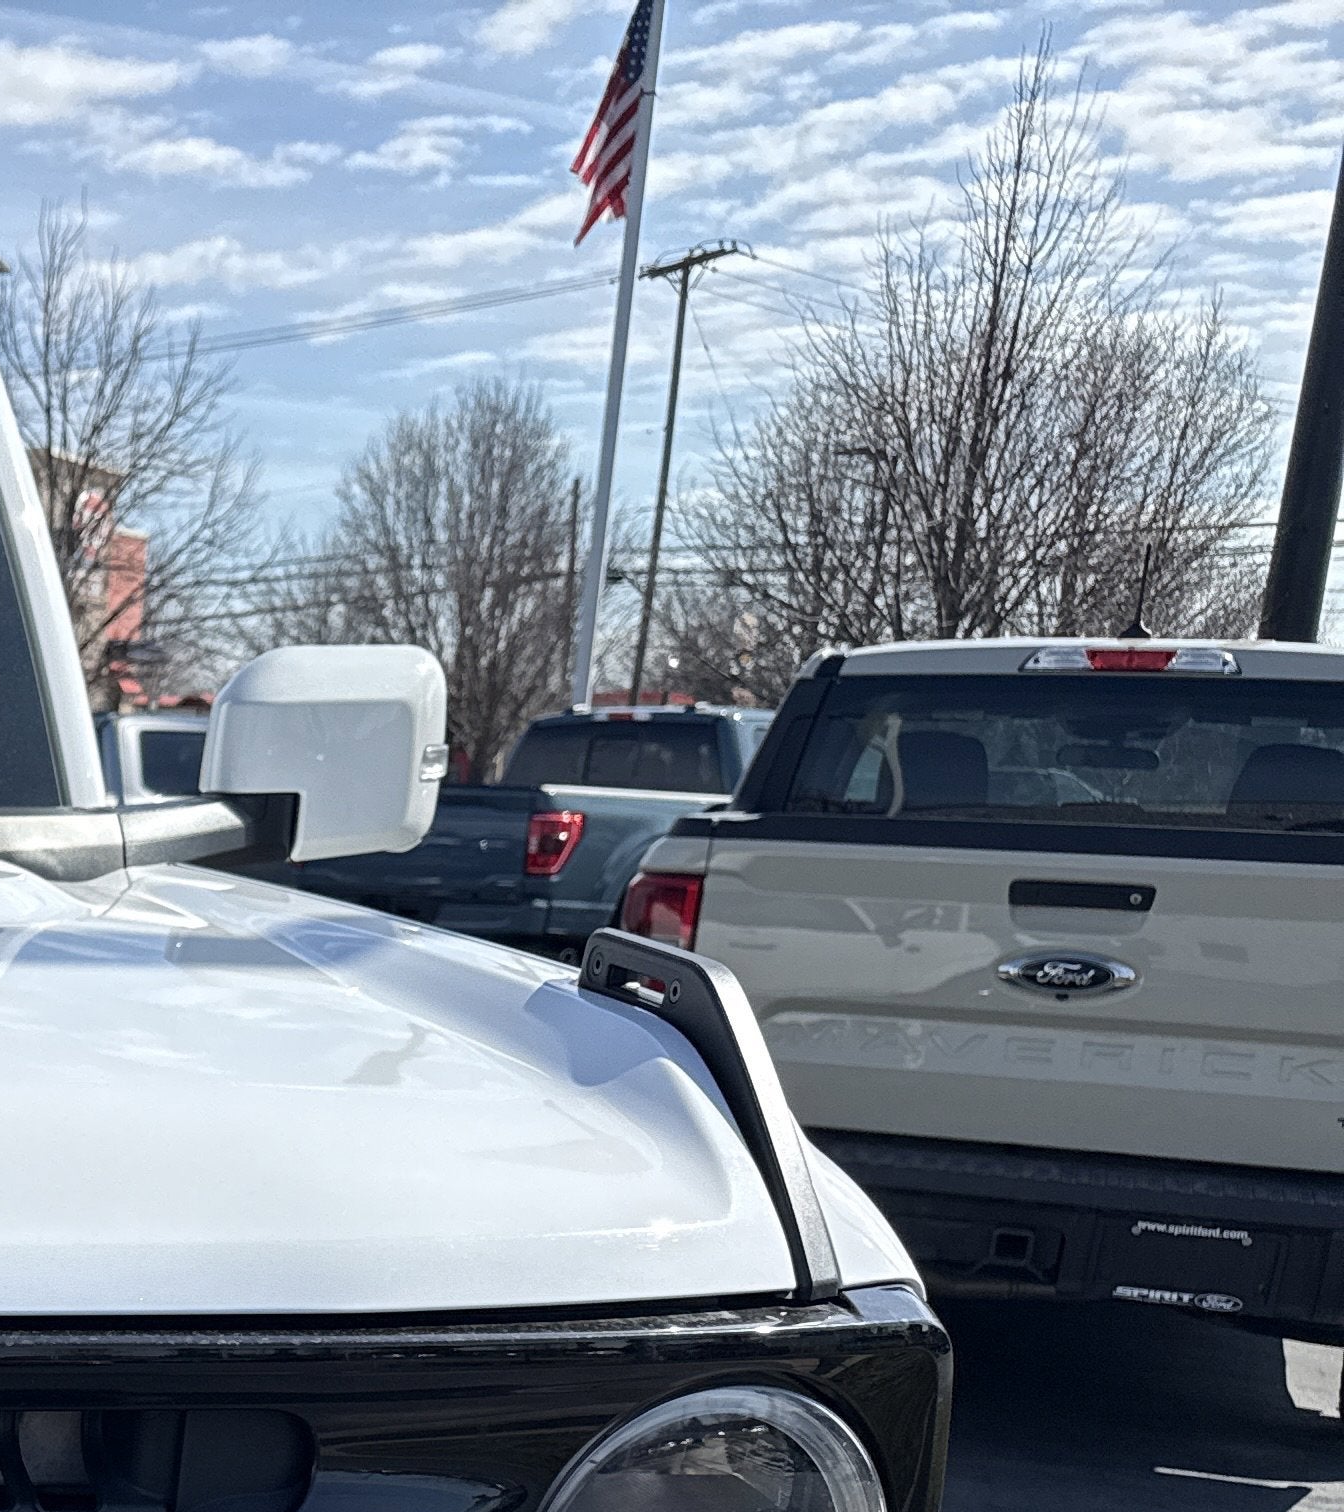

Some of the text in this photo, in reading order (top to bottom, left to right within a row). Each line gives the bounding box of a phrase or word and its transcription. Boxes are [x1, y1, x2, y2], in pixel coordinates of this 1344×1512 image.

[1036, 961, 1096, 986] Ford
[1137, 1220, 1249, 1240] www.spiritford.com
[1114, 1285, 1194, 1303] SPIRIT
